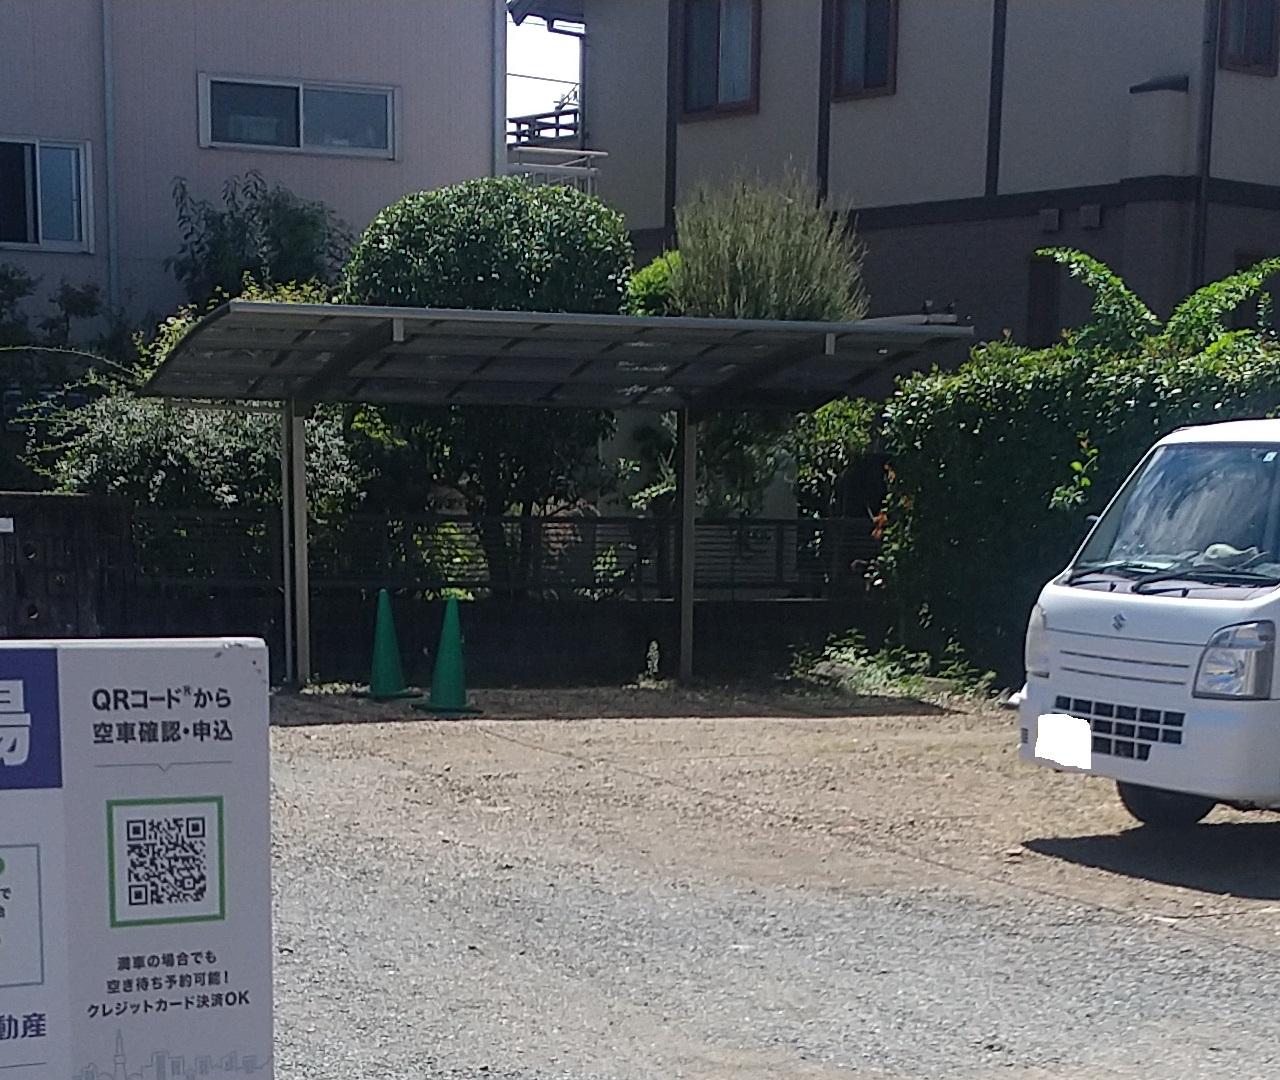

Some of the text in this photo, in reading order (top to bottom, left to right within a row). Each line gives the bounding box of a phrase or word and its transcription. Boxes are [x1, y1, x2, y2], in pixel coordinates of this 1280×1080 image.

[92, 719, 233, 744] 空車確認・申込
[117, 950, 217, 971] 満車の場合でも
[87, 990, 250, 1018] クレジットカード決済OK
